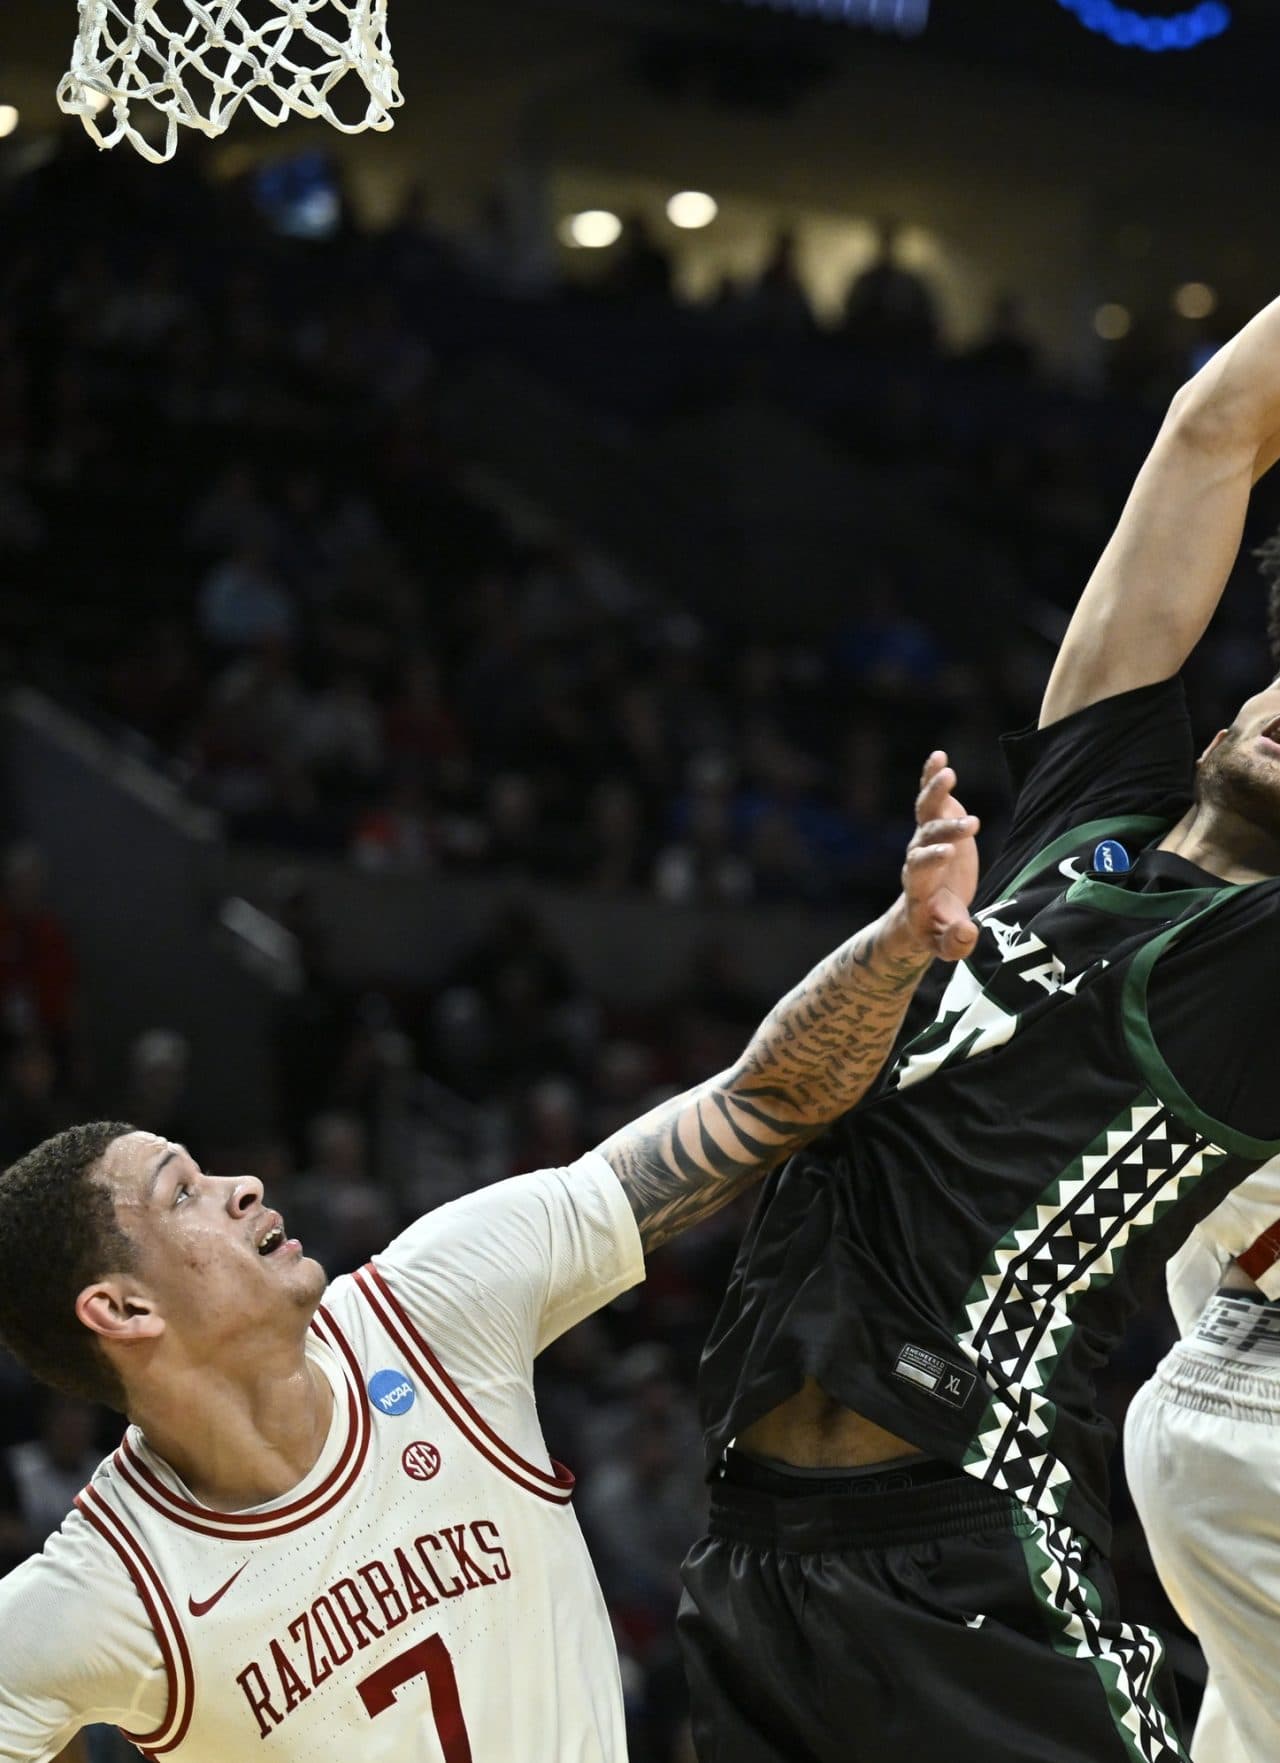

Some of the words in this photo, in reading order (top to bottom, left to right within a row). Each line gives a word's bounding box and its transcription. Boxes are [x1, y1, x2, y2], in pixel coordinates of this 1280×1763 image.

[904, 1346, 945, 1369] ENGINEERED
[380, 1382, 413, 1410] NCAA
[944, 1374, 961, 1396] XL
[405, 1443, 438, 1478] SEC
[236, 1520, 512, 1739] RAZORBACKS
[355, 1632, 473, 1763] 7
